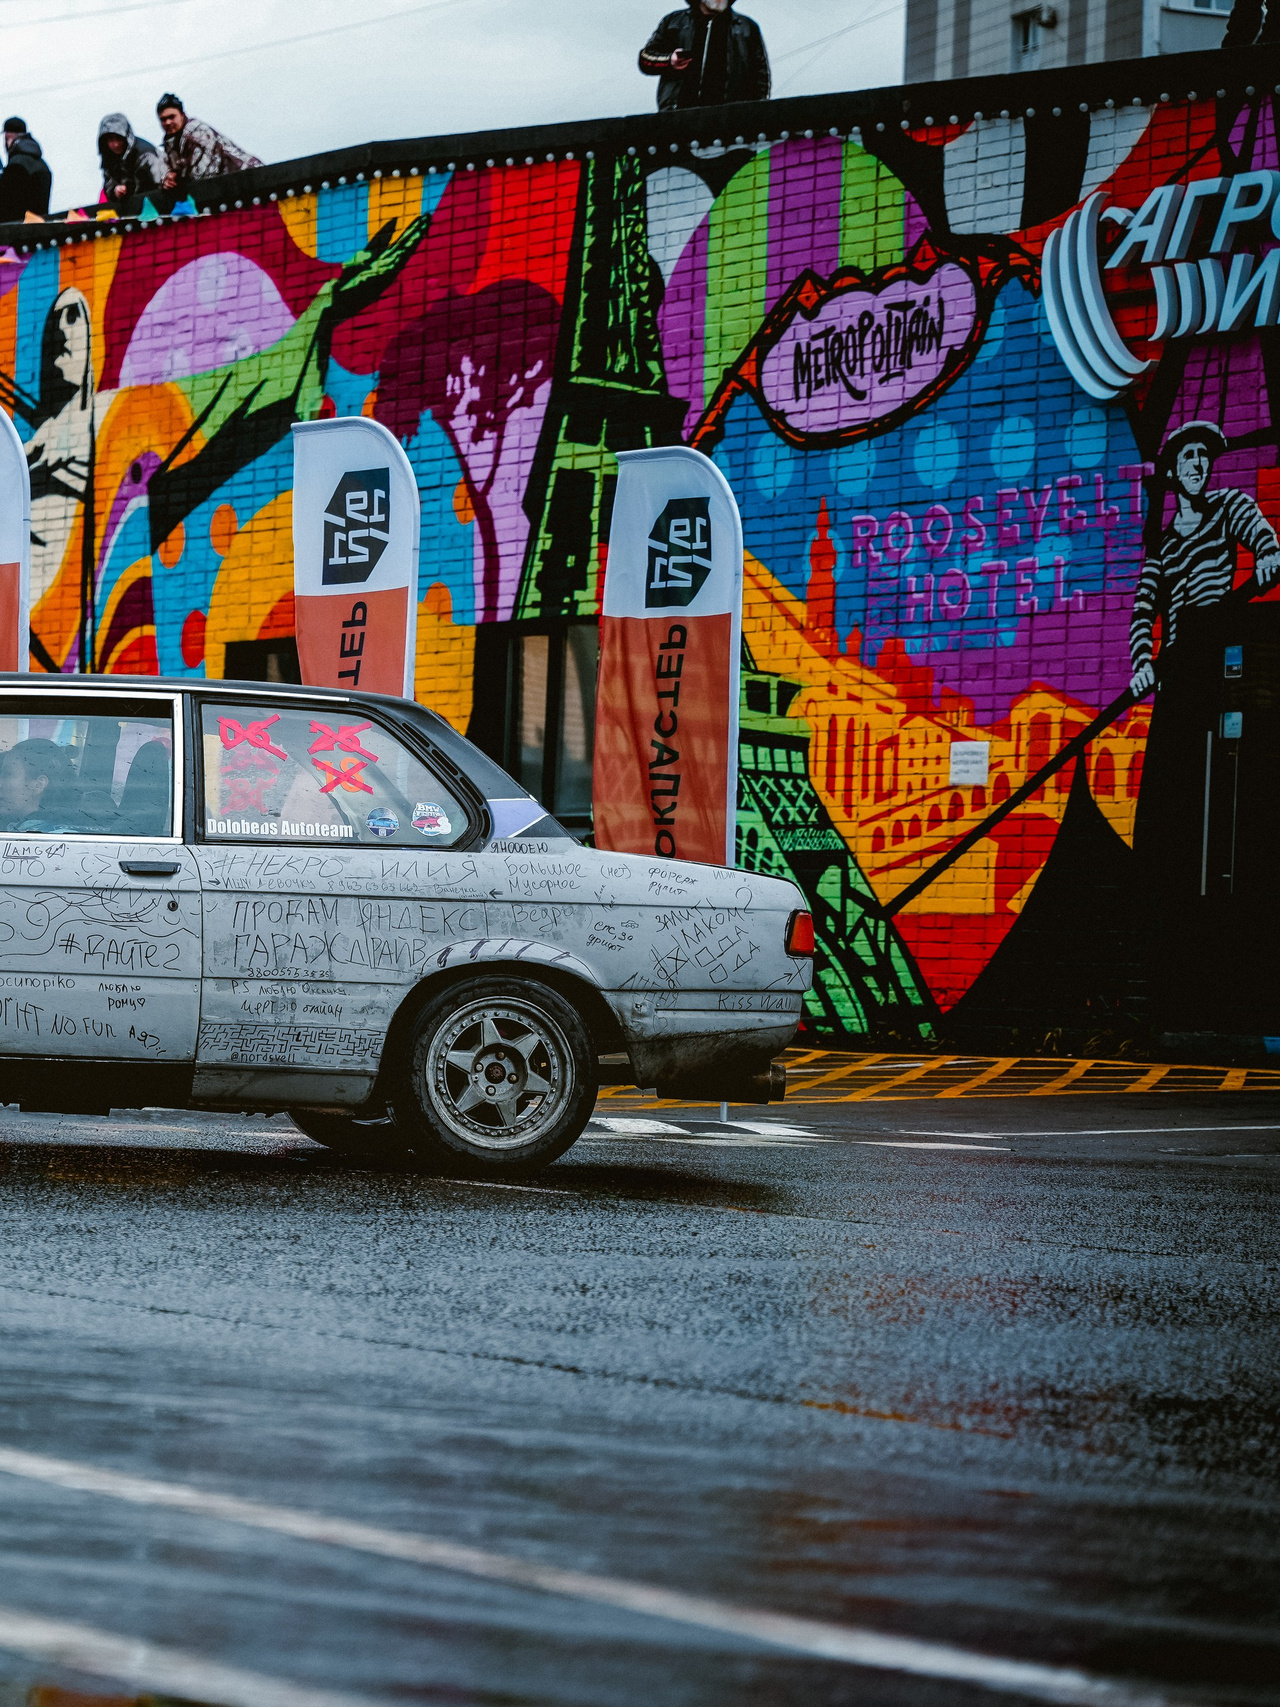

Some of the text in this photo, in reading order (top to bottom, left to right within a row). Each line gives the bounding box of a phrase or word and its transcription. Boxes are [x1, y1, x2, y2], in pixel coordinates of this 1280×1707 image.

[1104, 169, 1280, 270] АГР
[1147, 248, 1280, 342] ШИ
[852, 462, 1155, 567] ROOSEVELT
[905, 555, 1084, 622] HOTEL
[281, 820, 353, 838] Autoteam
[233, 898, 339, 932] ПРОДАМ
[356, 902, 478, 936] ЯНДЕКС
[234, 931, 348, 968] ГАРАЖ
